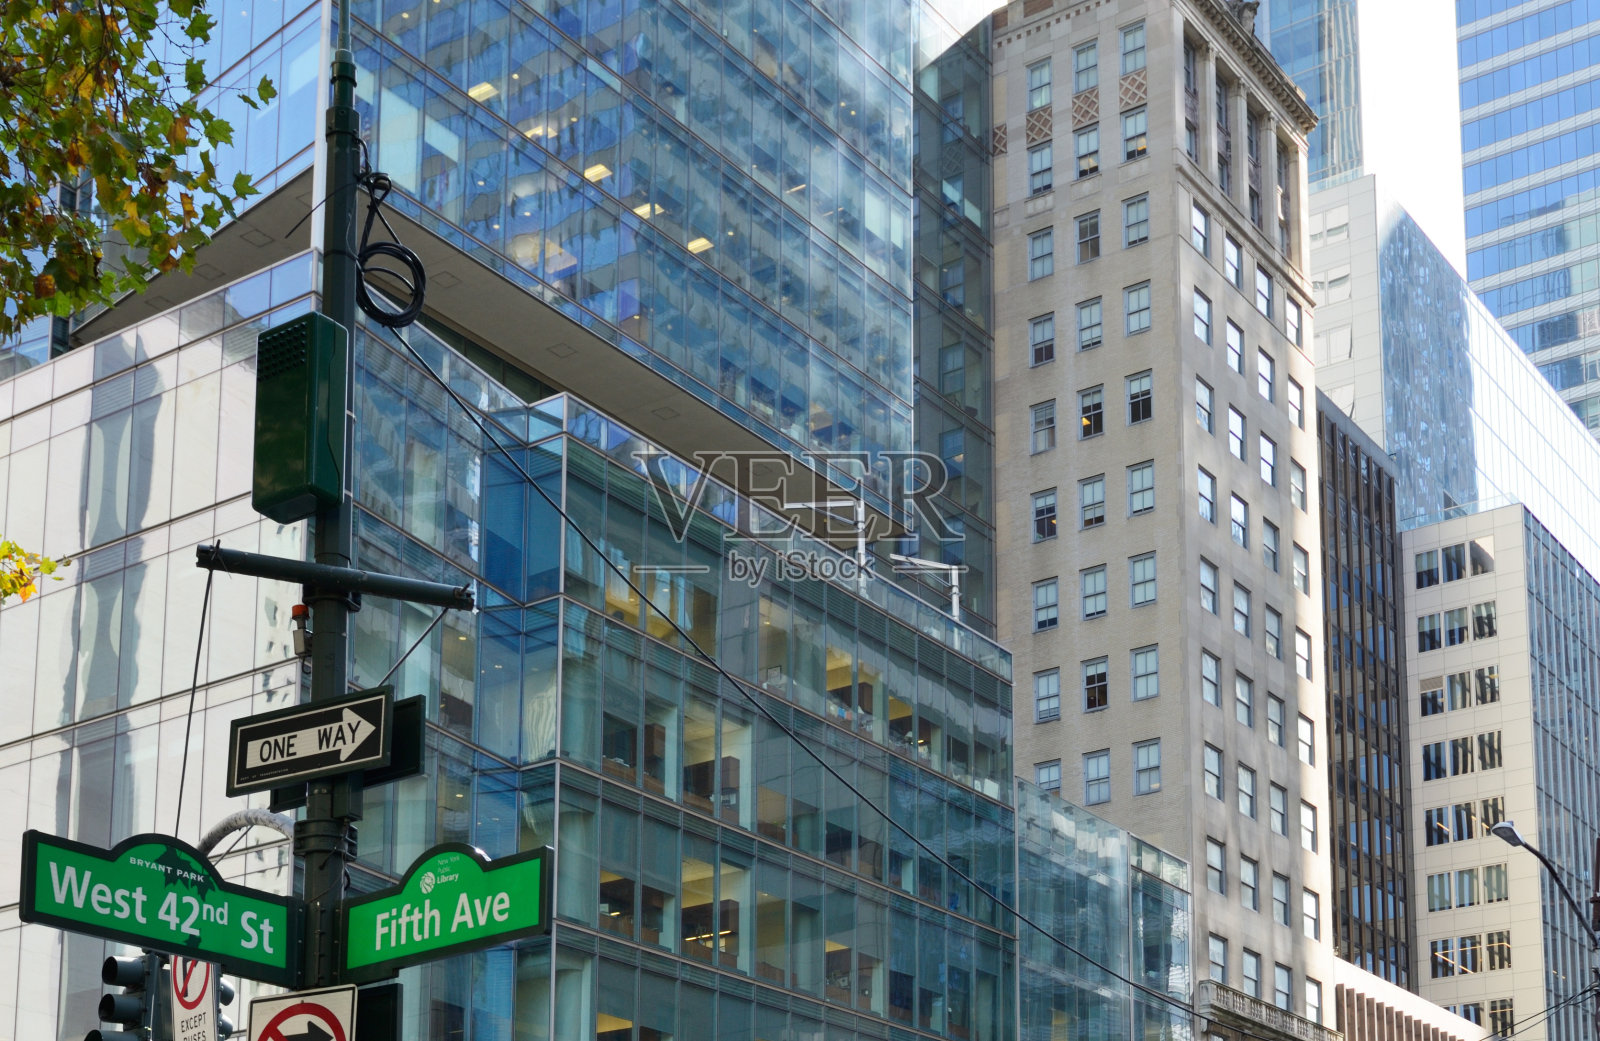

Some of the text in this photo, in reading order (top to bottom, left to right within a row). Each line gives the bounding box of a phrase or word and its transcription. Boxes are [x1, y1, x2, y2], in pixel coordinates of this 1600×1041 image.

[259, 720, 361, 763] ONE WAY
[129, 856, 205, 883] BRYANT PARK
[436, 872, 459, 884] Library
[49, 861, 274, 954] West 42nd St
[375, 891, 511, 951] Fifth Ave
[181, 1012, 207, 1033] EXCEPT
